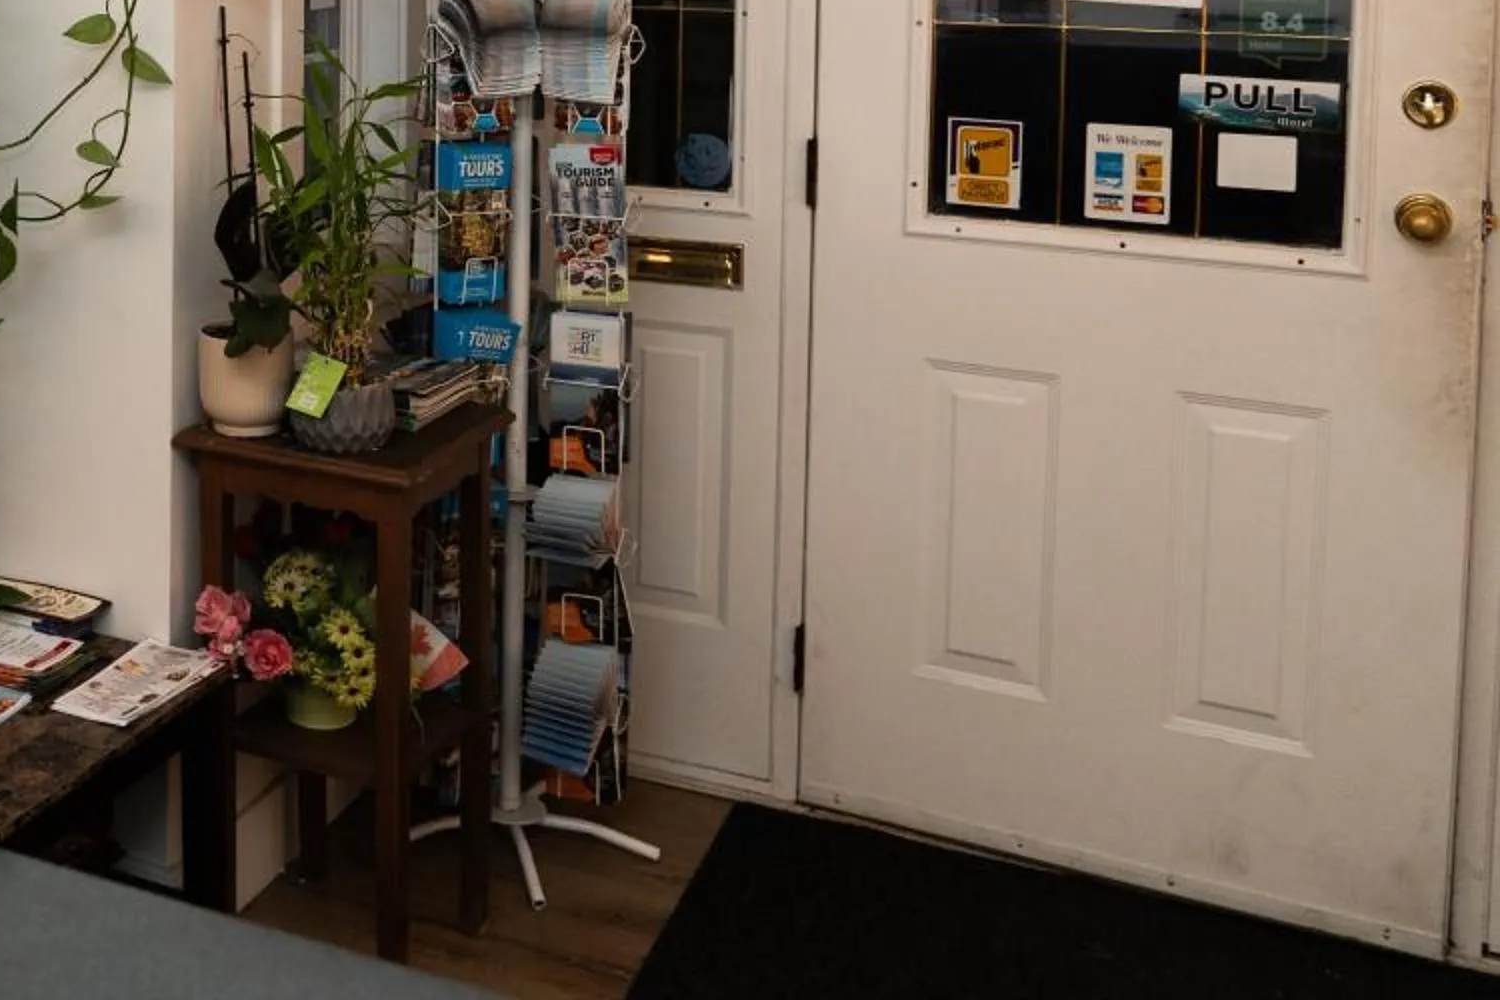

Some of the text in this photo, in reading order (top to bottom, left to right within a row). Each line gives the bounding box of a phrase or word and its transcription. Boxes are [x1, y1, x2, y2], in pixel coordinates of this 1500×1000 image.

[1261, 11, 1304, 33] 8.4
[1203, 81, 1315, 114] PULL
[458, 159, 505, 178] TOURS
[555, 167, 615, 179] TOURISM
[574, 177, 615, 188] GUIDE
[467, 330, 513, 351] TOURS
